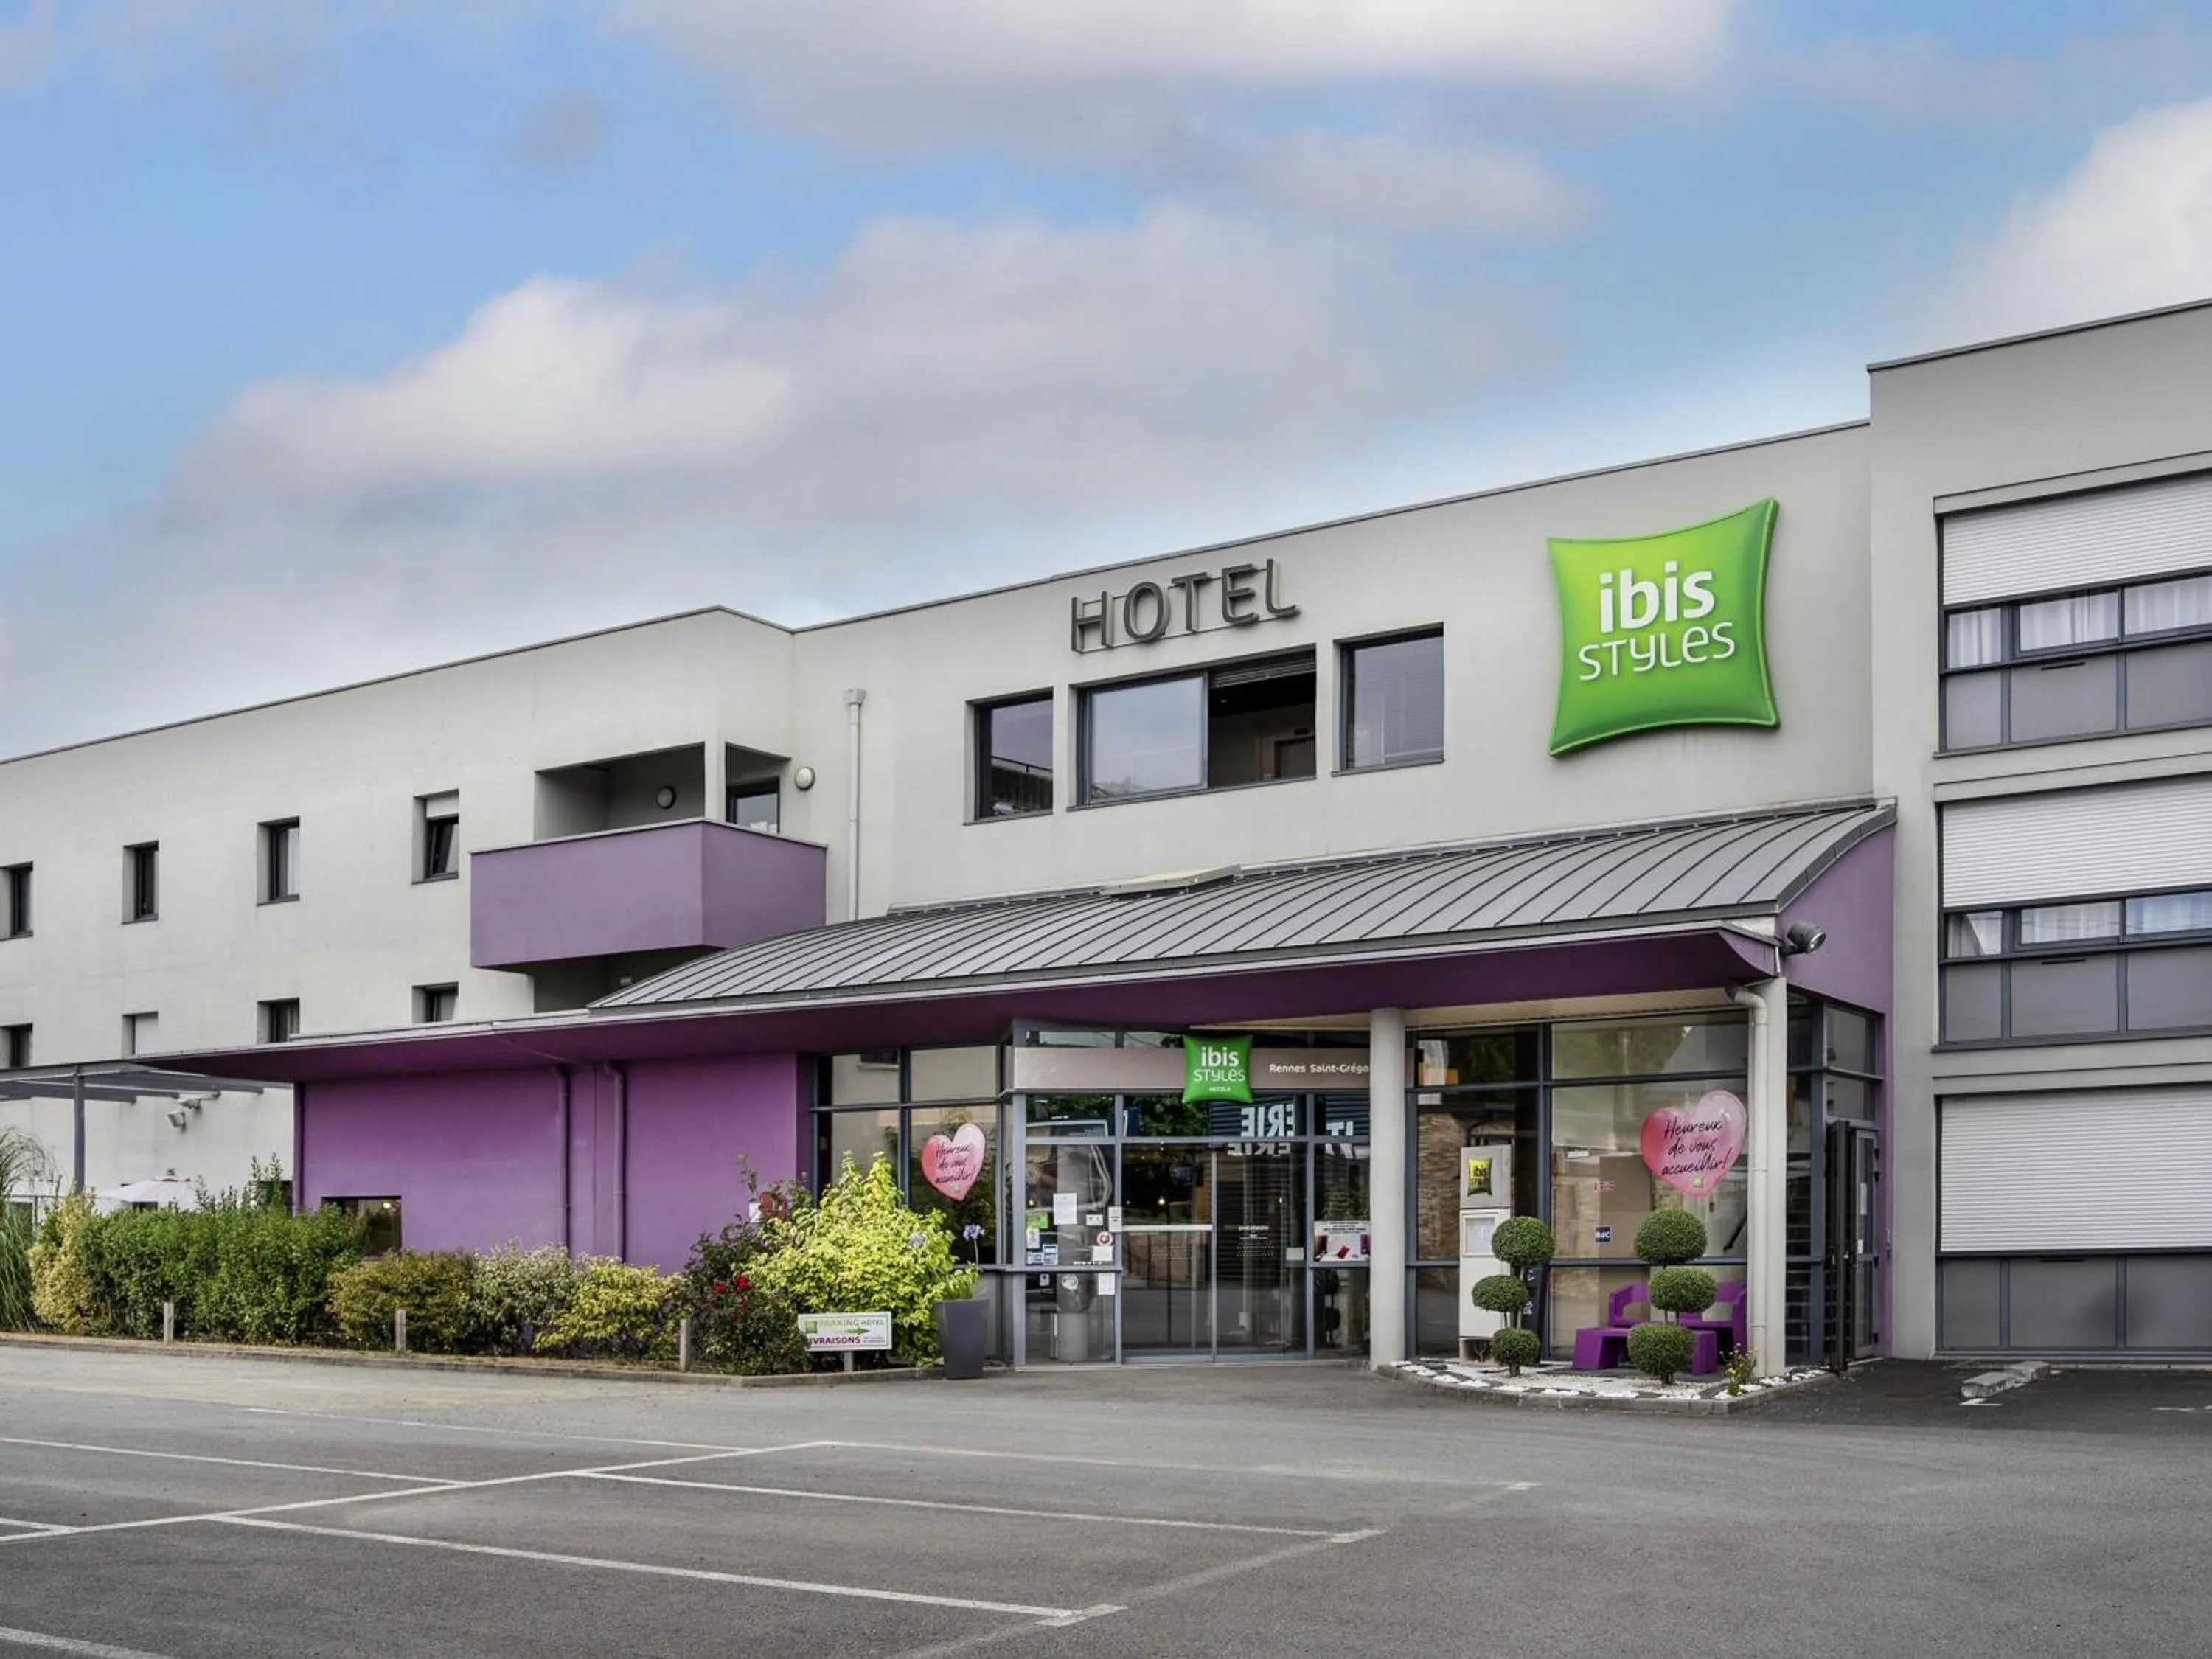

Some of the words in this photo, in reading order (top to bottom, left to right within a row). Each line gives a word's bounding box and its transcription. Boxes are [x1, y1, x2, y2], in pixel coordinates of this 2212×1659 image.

[1071, 558, 1298, 652] HOTEL
[1599, 560, 1716, 633] ibis
[1201, 1046, 1239, 1067] ibis
[1269, 1063, 1306, 1074] Rennes
[1664, 1116, 1723, 1139] Heureux
[1668, 1138, 1684, 1159] de
[1689, 1138, 1718, 1152] vous
[1661, 1146, 1733, 1176] accueillir!
[810, 1335, 861, 1345] IVRAISONS
